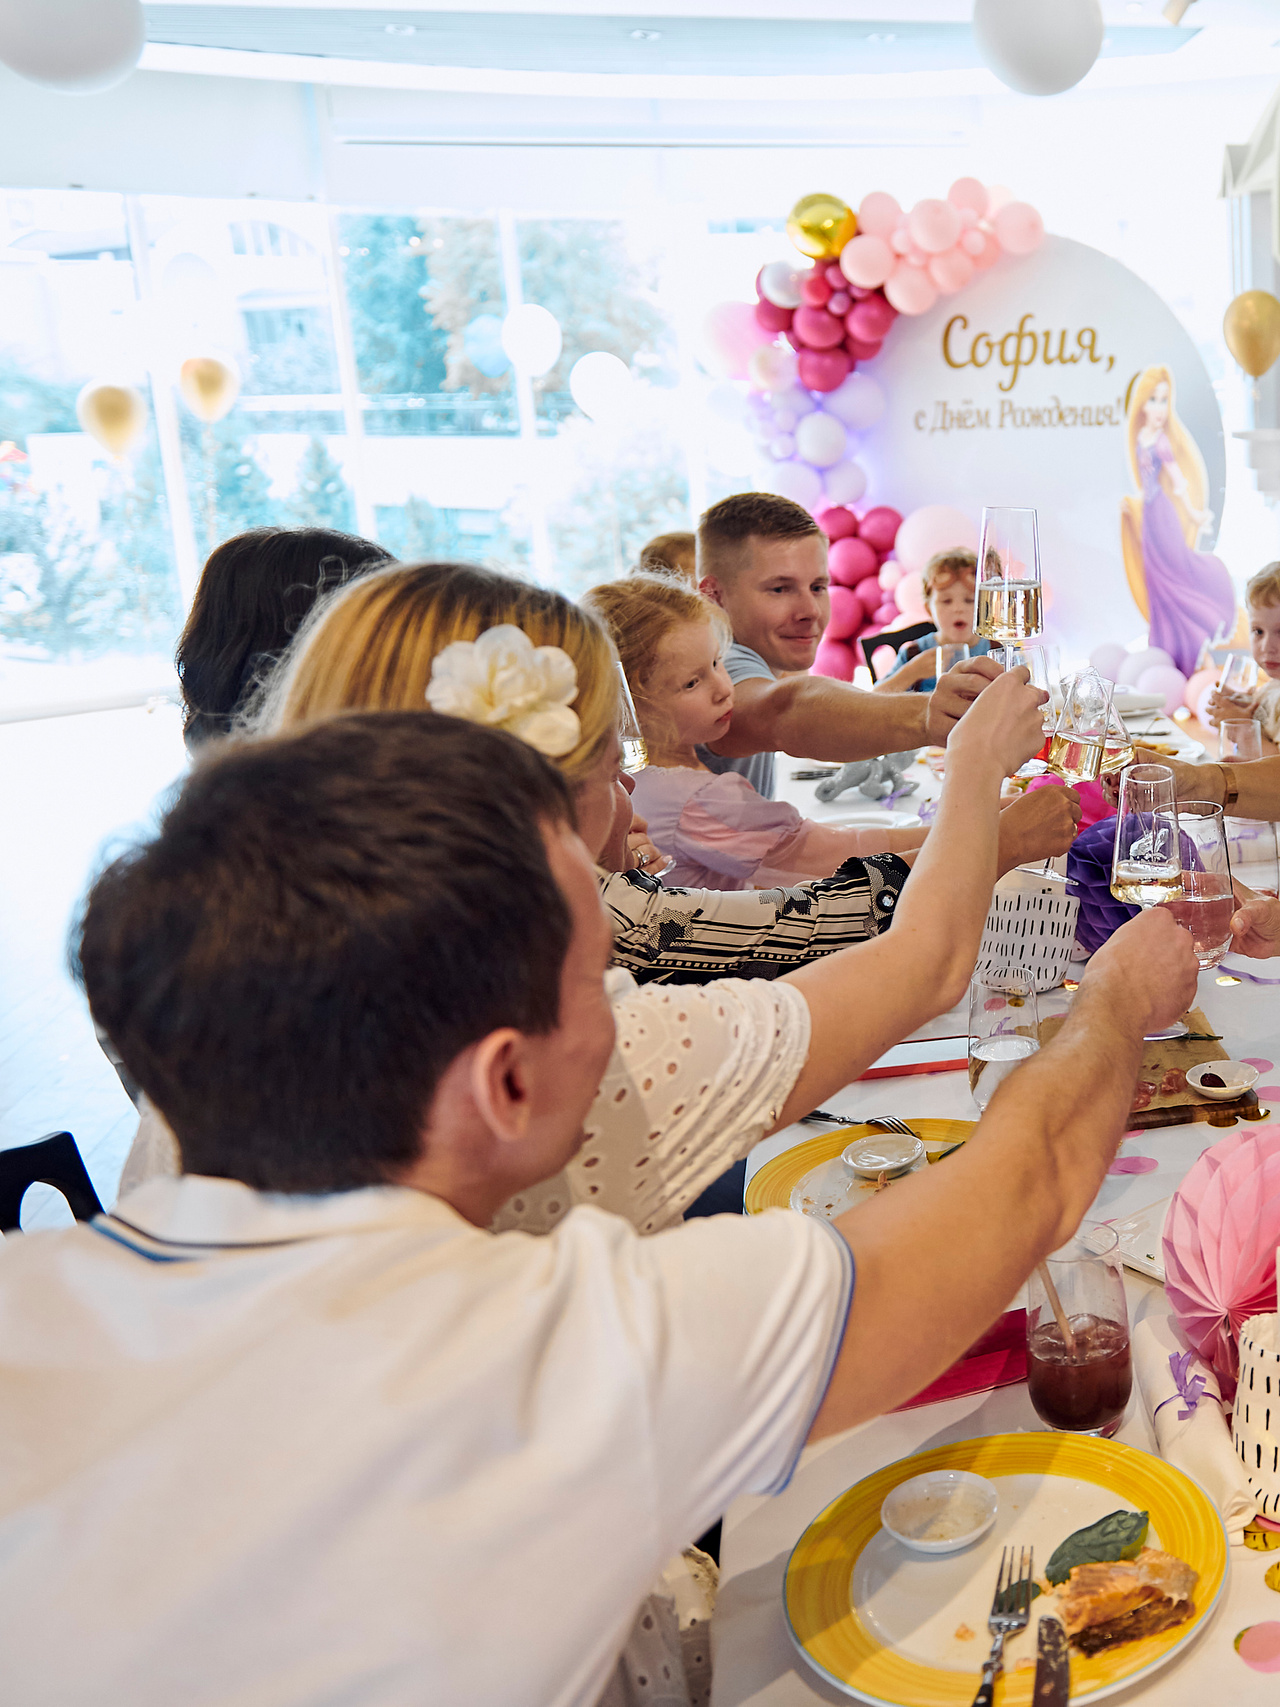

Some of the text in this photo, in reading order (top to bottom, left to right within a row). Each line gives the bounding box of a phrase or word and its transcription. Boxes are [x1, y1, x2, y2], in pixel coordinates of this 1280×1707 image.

[941, 313, 1116, 392] София,
[914, 395, 1122, 435] с Днём Рождения!
